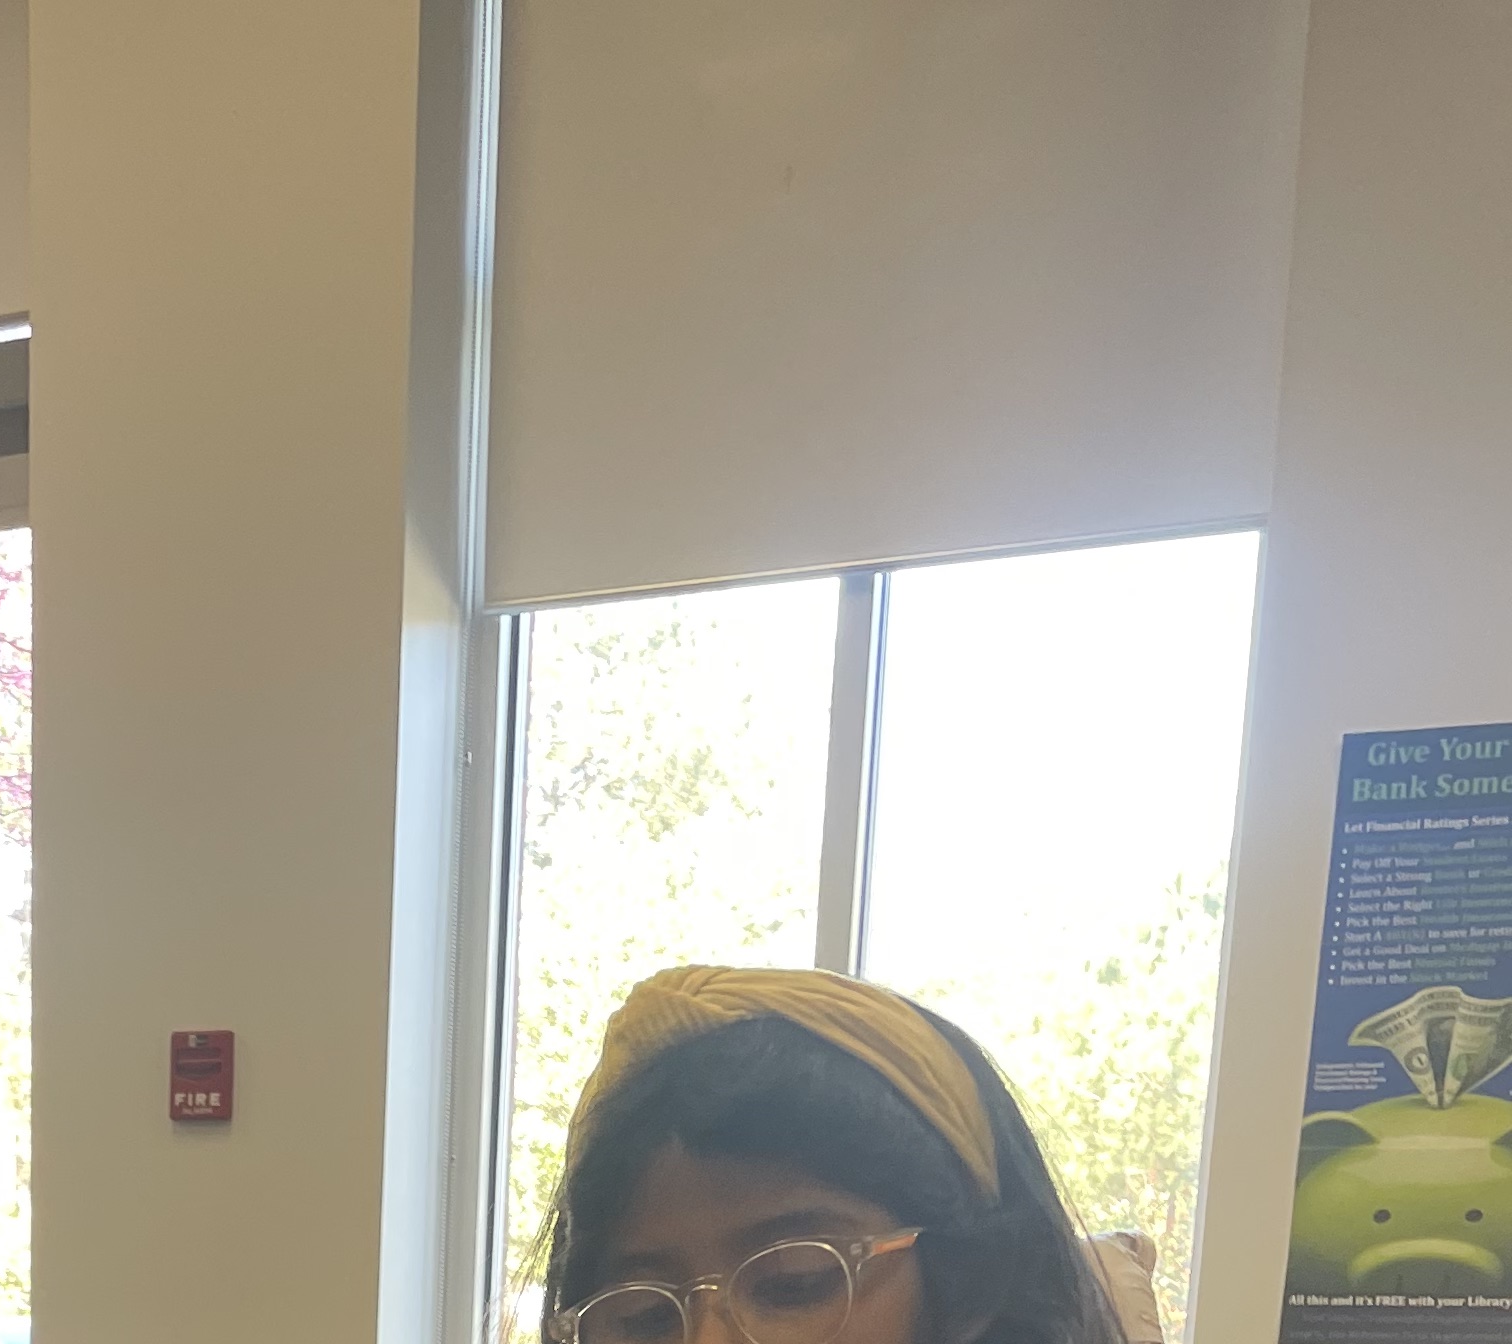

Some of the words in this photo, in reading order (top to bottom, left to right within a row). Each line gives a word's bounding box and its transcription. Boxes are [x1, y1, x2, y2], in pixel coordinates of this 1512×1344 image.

[1367, 741, 1431, 766] Give
[1439, 737, 1510, 761] Your
[1352, 775, 1428, 802] Bank
[1434, 773, 1512, 798] Some
[1344, 821, 1363, 834] Let
[1366, 819, 1421, 833] Financial
[1423, 817, 1469, 830] Ratings
[1470, 815, 1510, 827] Series
[174, 1092, 221, 1107] FIRE
[1288, 1294, 1305, 1306] All
[1306, 1294, 1329, 1306] this
[1330, 1295, 1354, 1306] and
[1375, 1295, 1407, 1307] FREE
[1408, 1295, 1435, 1307] with
[1436, 1297, 1466, 1309] your
[1467, 1295, 1511, 1310] Library
